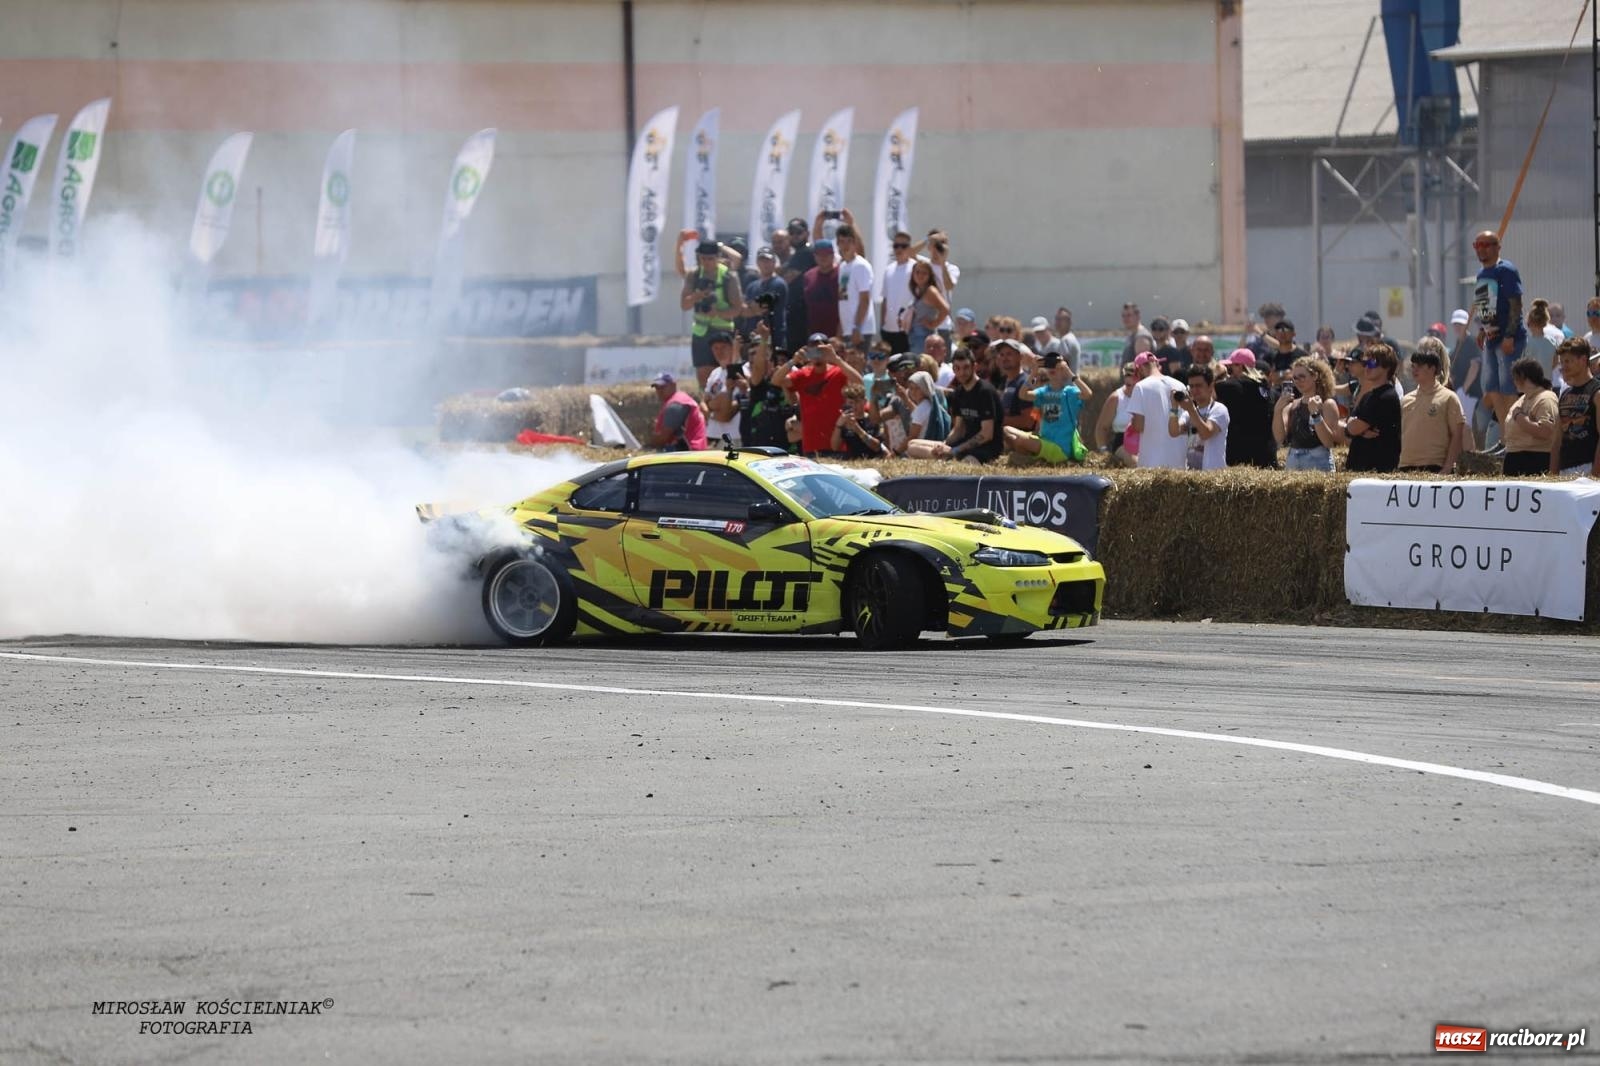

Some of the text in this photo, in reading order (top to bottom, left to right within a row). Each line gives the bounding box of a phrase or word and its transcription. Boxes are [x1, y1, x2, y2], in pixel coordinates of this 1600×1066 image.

[460, 287, 585, 331] OPEN
[907, 498, 969, 511] AUTO FUS
[986, 490, 1068, 526] INEOS
[1386, 484, 1543, 514] AUTO FUS
[726, 522, 744, 533] 170
[1408, 542, 1513, 572] GROUP
[649, 570, 824, 612] PILOT
[737, 614, 792, 623] DRIFT TEAM
